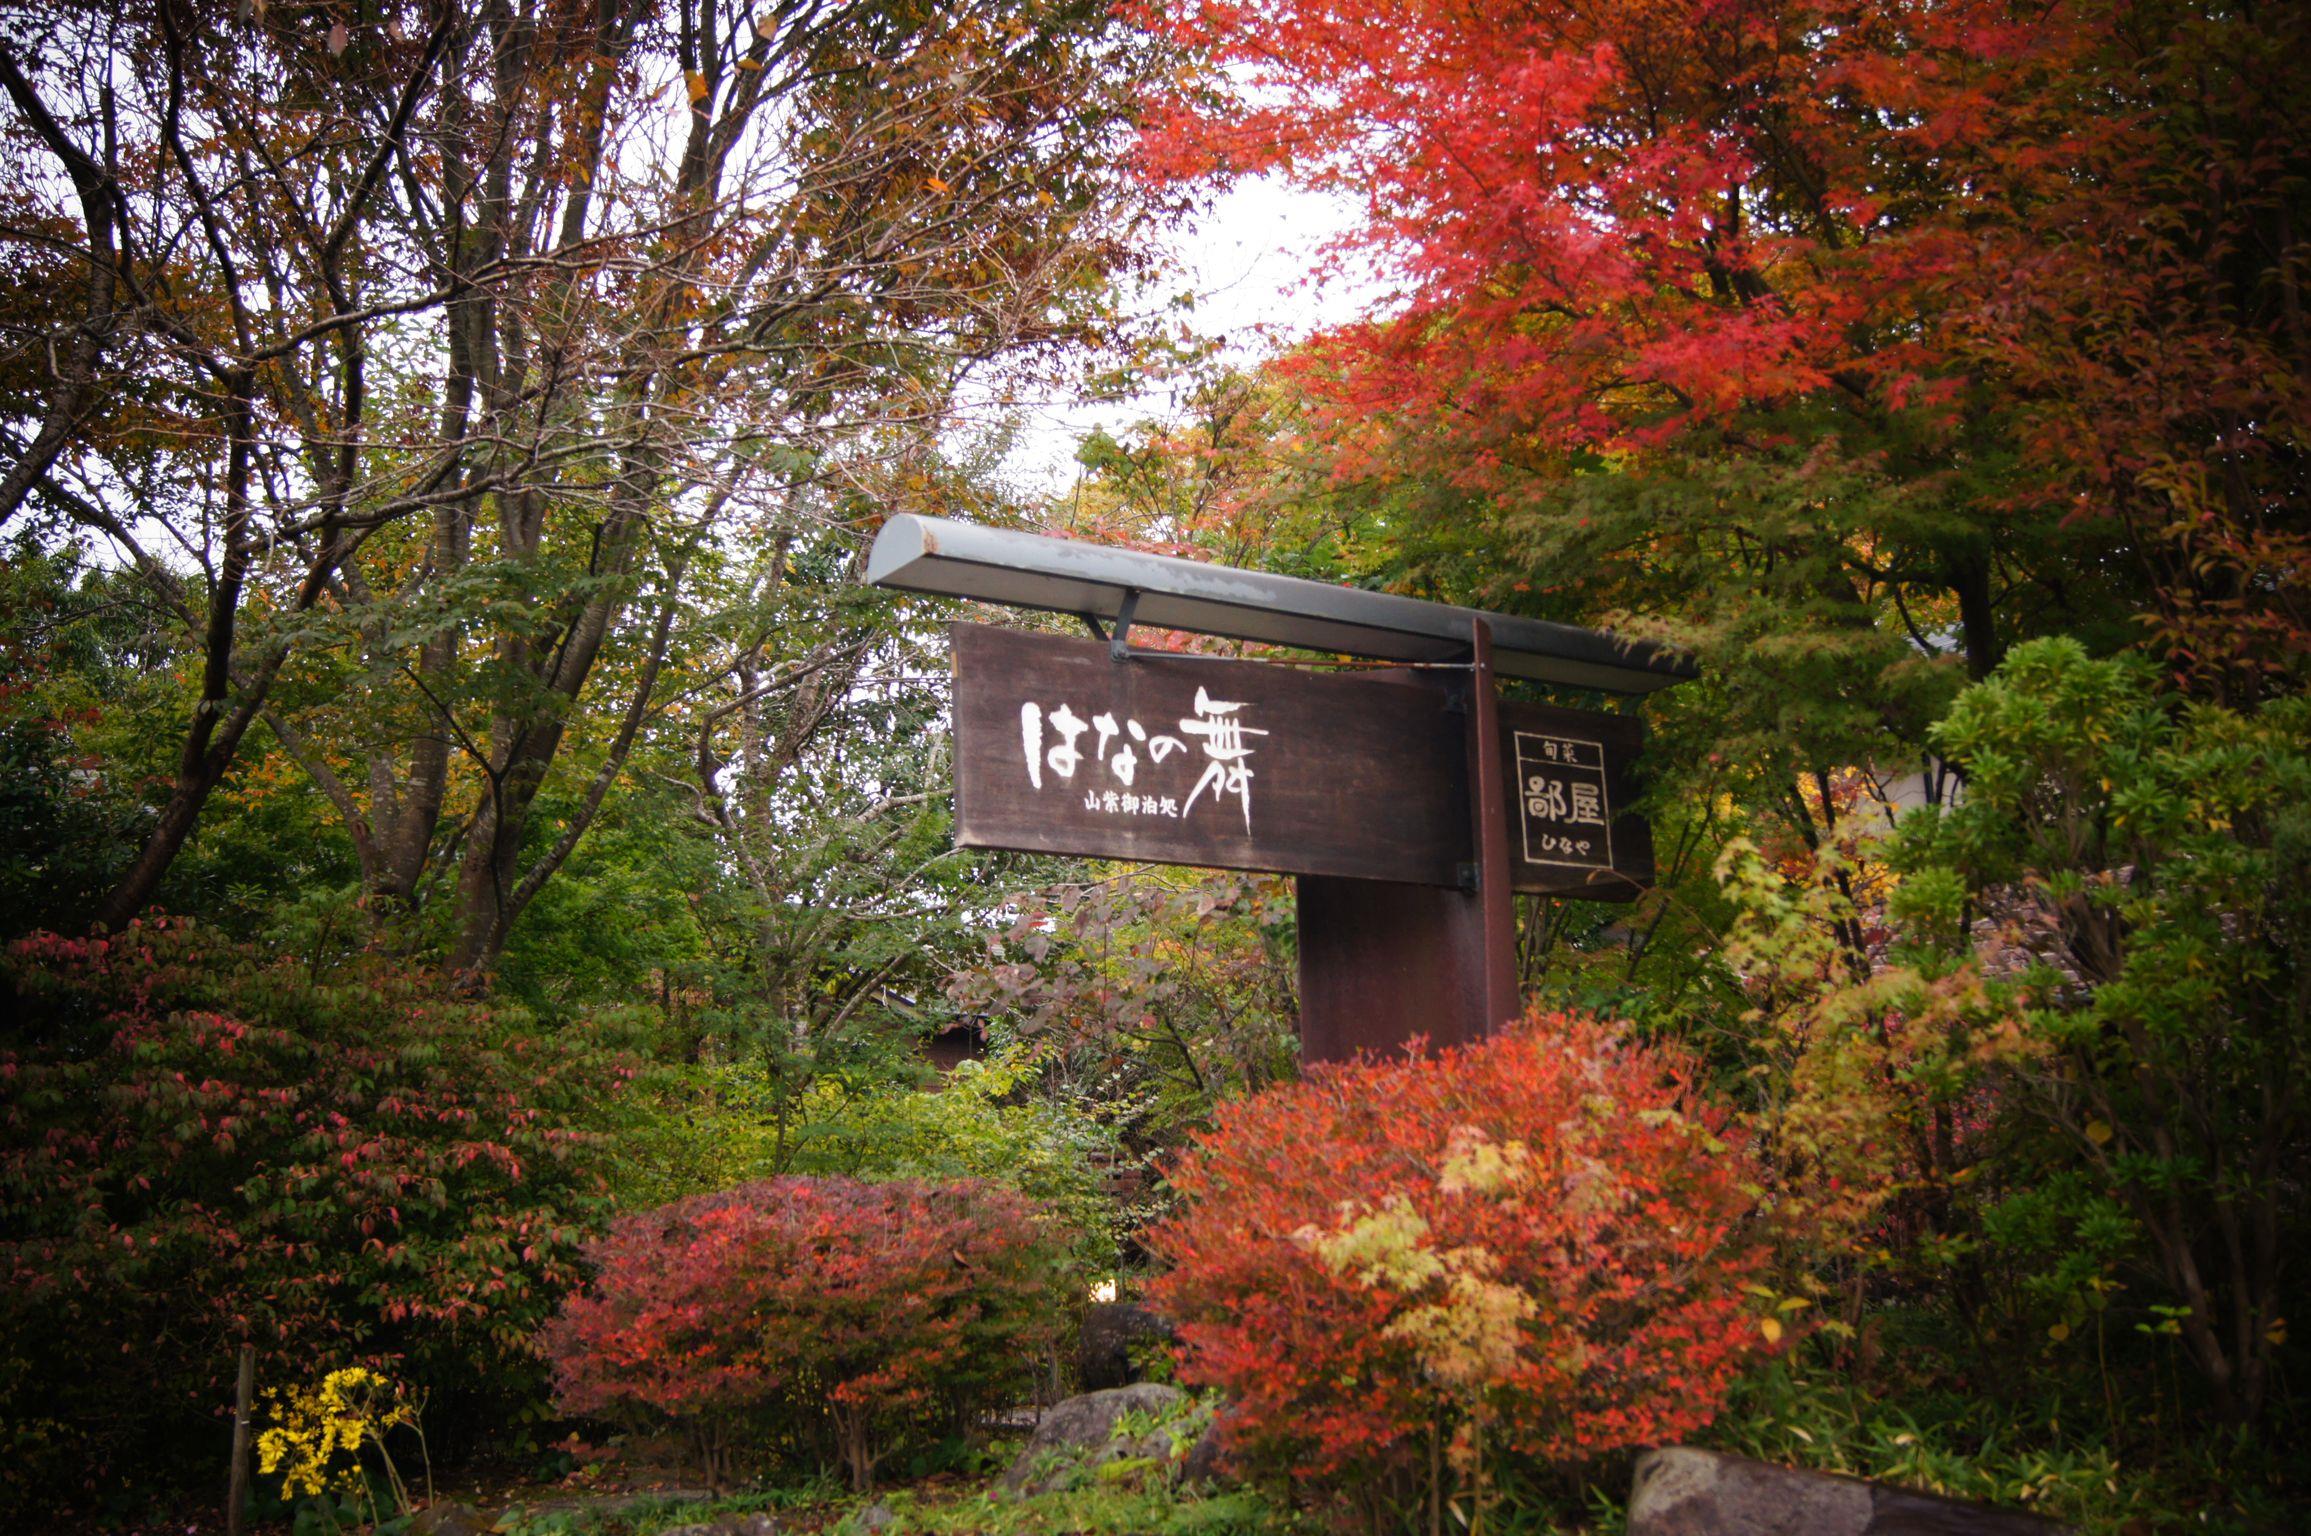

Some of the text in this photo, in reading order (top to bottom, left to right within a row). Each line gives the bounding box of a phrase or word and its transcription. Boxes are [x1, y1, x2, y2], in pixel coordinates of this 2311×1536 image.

[1020, 685, 1269, 836] はなの舞
[1543, 741, 1578, 763] 旬菜
[1542, 834, 1591, 856] ひなや
